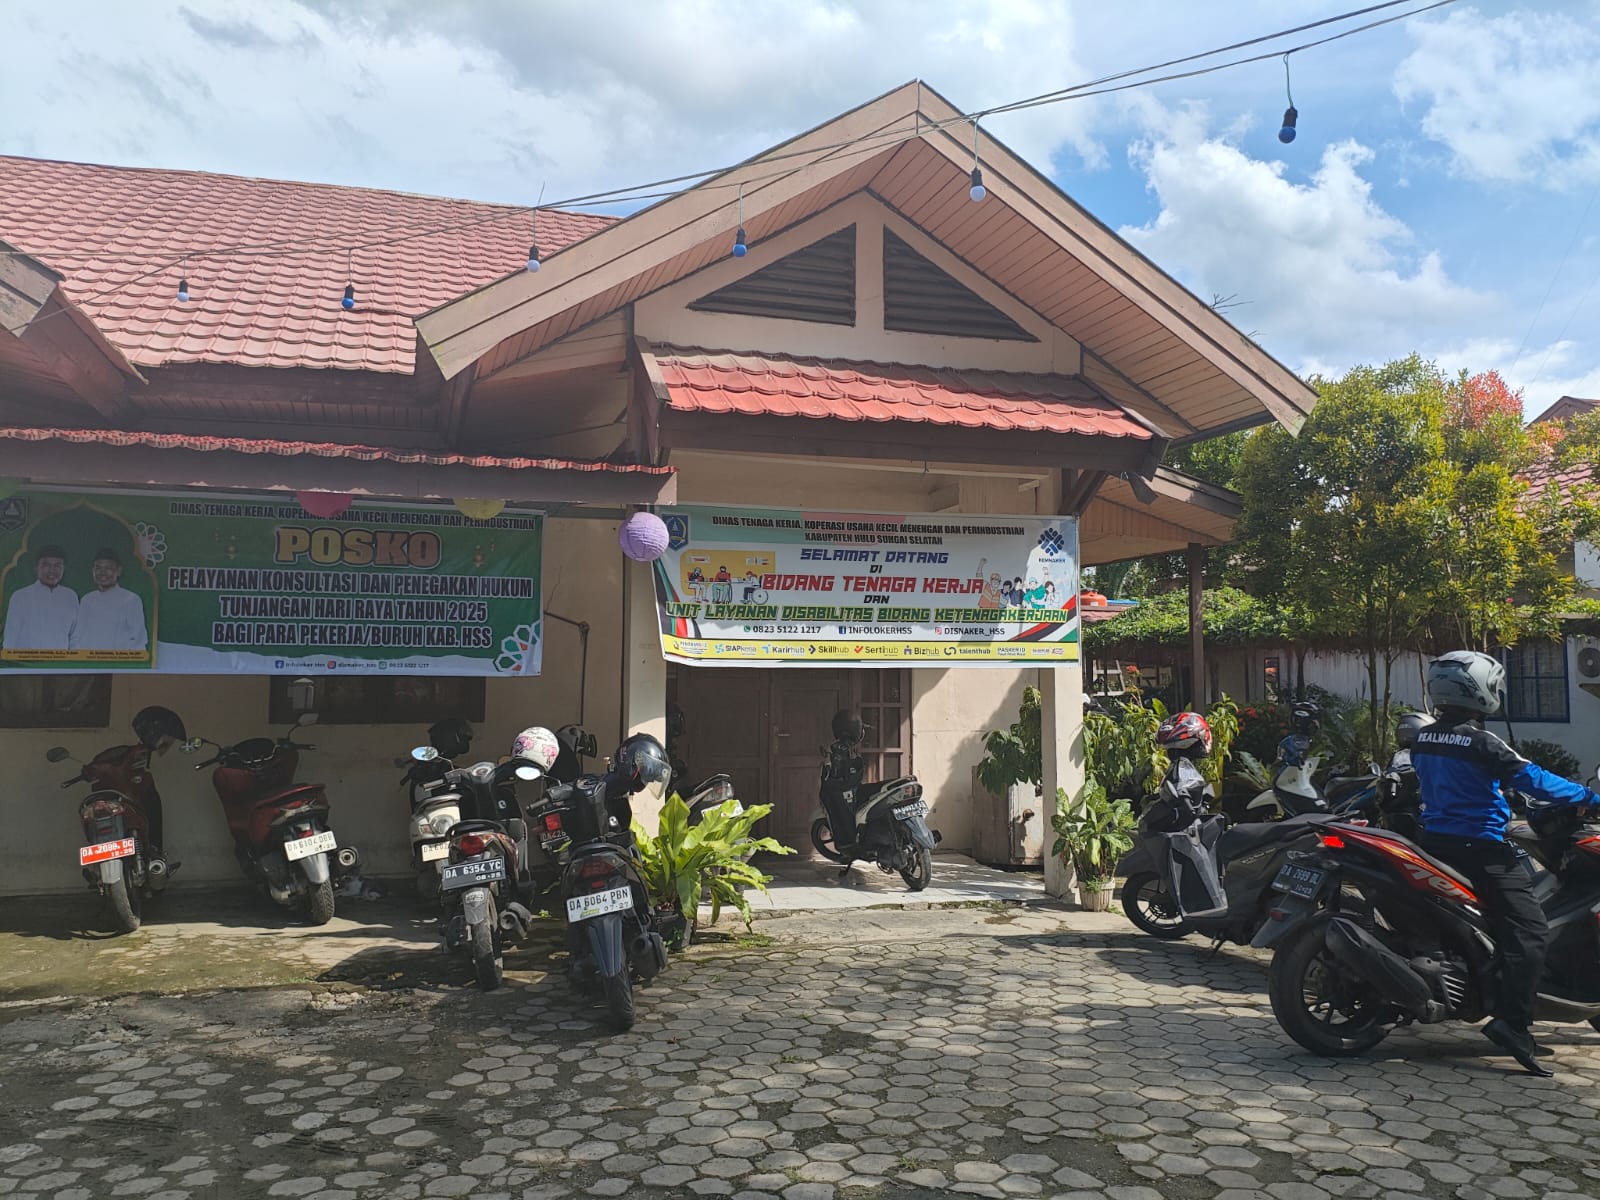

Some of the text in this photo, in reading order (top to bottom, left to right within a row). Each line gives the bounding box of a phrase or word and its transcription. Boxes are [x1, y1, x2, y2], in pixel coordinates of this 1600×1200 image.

[171, 503, 202, 515] DINAS
[204, 504, 242, 517] TENAGA
[245, 507, 275, 519] KERJA,
[363, 510, 388, 522] KECIL
[391, 512, 441, 525] MENENGAH
[443, 514, 462, 526] DAN
[712, 516, 1025, 536] DINAS TENAGA KERJA, KOPERASI USAHA KECIL MENENGAH DAN PERINDUSTRIAN
[805, 532, 943, 545] KABUPATEN HULU SUNGAI SELATAN
[275, 526, 441, 568] POSKO
[800, 548, 949, 564] SELAMAT DATANG
[870, 564, 883, 573] DI
[169, 567, 532, 598] PELAYANAN KONSULTASI DAN PENEGAKAN HUKUM
[762, 573, 984, 594] BIDANG TENAGA KERJA
[864, 595, 890, 604] DAN
[220, 596, 487, 622] TUNJANGAN HARI RAYA TAHUN 2025
[666, 603, 1069, 623] UNIT LAYANAN DISABILITAS BIDANG KETENAGAKERJAAN
[214, 622, 491, 647] BAGI PARA PEKERJA/BURUH KAB. HSS
[752, 625, 821, 634] 0823 5122 1217
[849, 626, 912, 635] INFOLOKERHSS
[944, 627, 1005, 637] DISNAKER_HSS
[772, 646, 804, 654] Karirhub
[818, 645, 849, 653] Skillhub
[865, 645, 898, 654] Sertihub
[914, 647, 939, 655] Bizhub
[1417, 732, 1472, 747] REALMADRID
[83, 848, 93, 857] DA
[445, 861, 501, 879] DA 6354 YC
[569, 888, 628, 911] DA 6064 PBN
